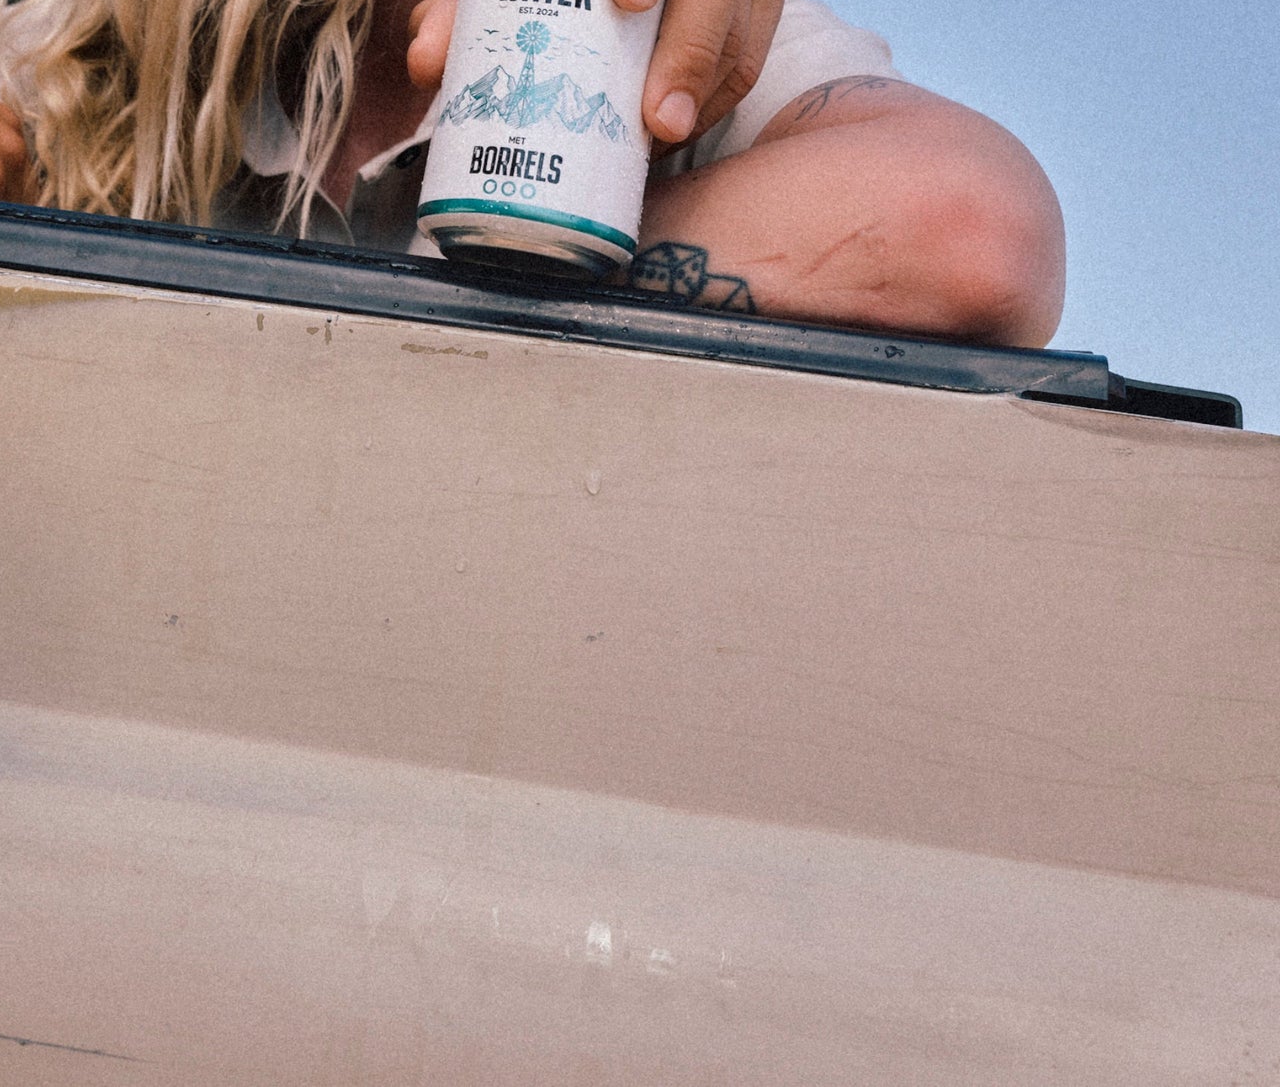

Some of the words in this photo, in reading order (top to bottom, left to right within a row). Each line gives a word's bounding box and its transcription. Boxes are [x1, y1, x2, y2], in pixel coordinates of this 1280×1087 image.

[518, 6, 535, 16] EST.
[536, 8, 559, 18] 2024
[508, 136, 527, 146] MET
[469, 145, 564, 185] BORRELS
